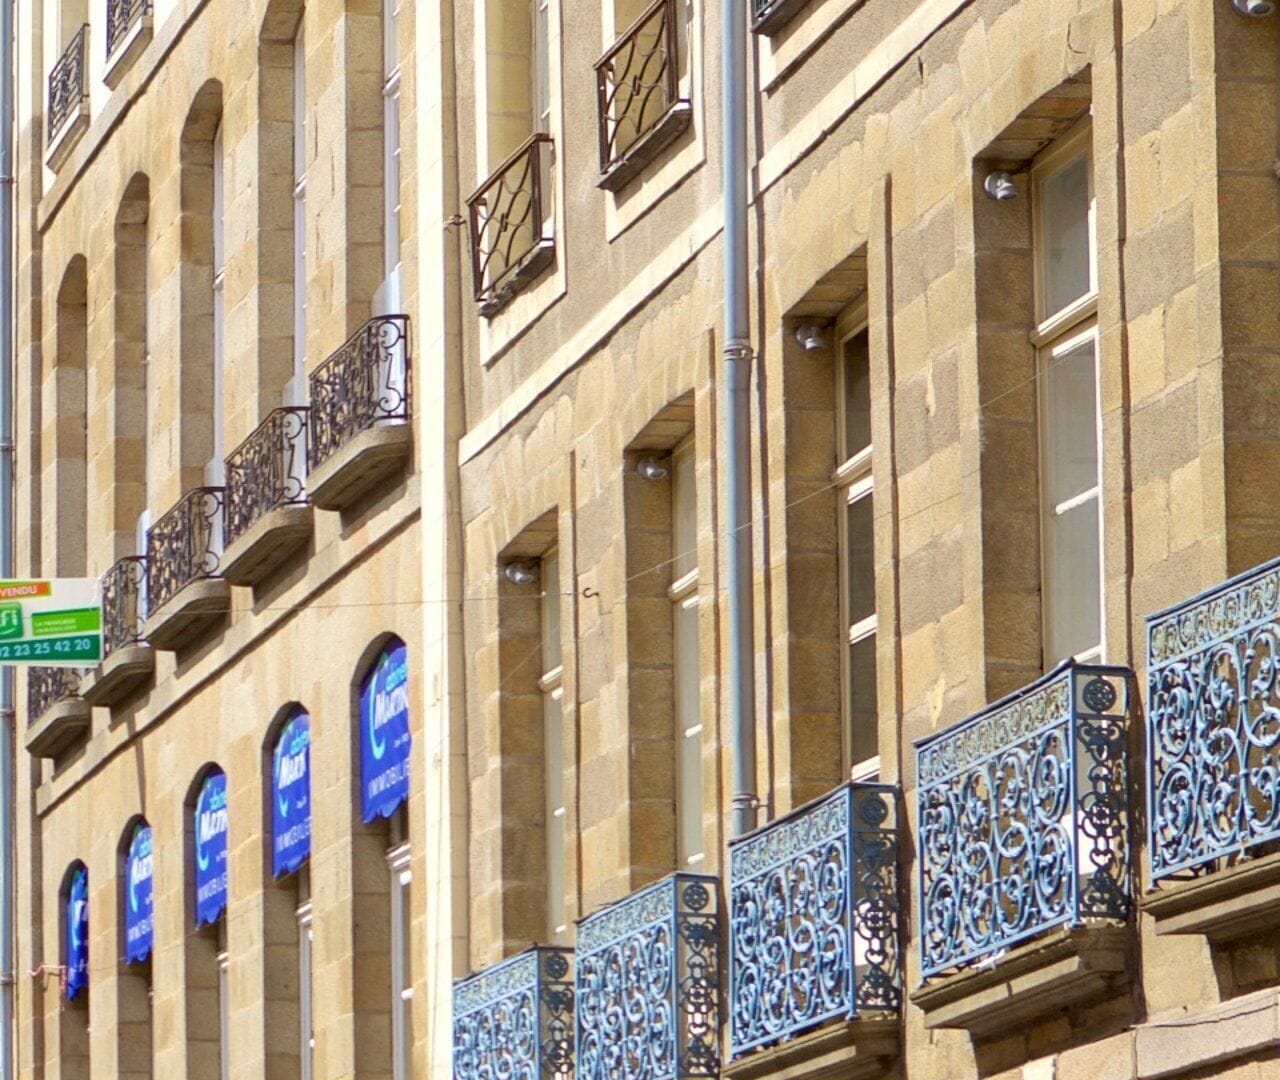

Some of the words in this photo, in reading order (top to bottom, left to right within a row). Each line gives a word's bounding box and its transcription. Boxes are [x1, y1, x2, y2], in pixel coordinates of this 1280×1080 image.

[0, 585, 38, 598] VENDU
[14, 644, 30, 656] 23
[34, 642, 51, 654] 25
[54, 640, 71, 652] 42
[75, 638, 91, 650] 20
